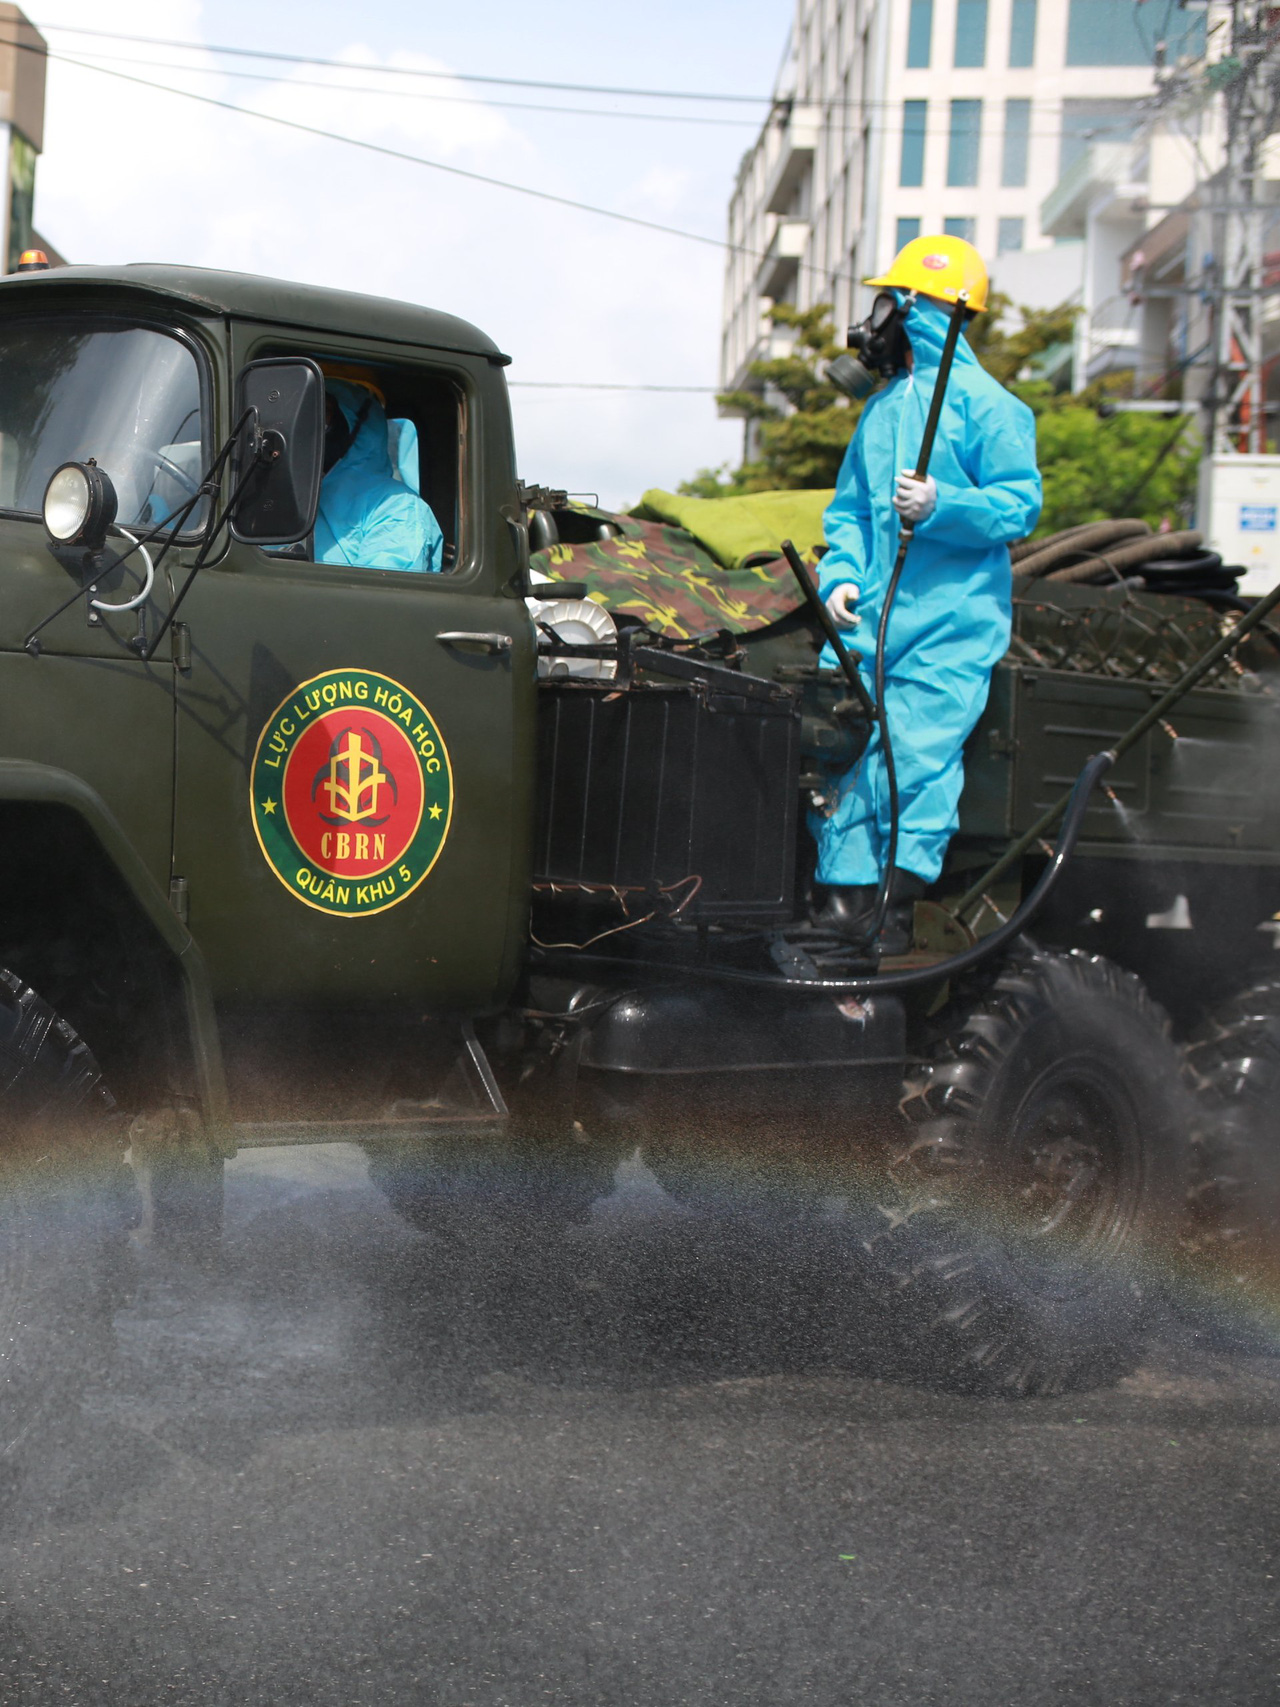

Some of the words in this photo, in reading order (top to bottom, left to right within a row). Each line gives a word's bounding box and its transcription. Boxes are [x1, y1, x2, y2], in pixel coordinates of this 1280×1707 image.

[264, 718, 296, 768] LỰC
[293, 680, 369, 720] LƯỢNG
[373, 686, 414, 727] HÓA
[411, 722, 441, 774] HỌC
[321, 832, 386, 860] CBRN
[295, 866, 350, 905] QUÂN
[356, 875, 396, 905] KHU
[398, 864, 412, 883] 5
